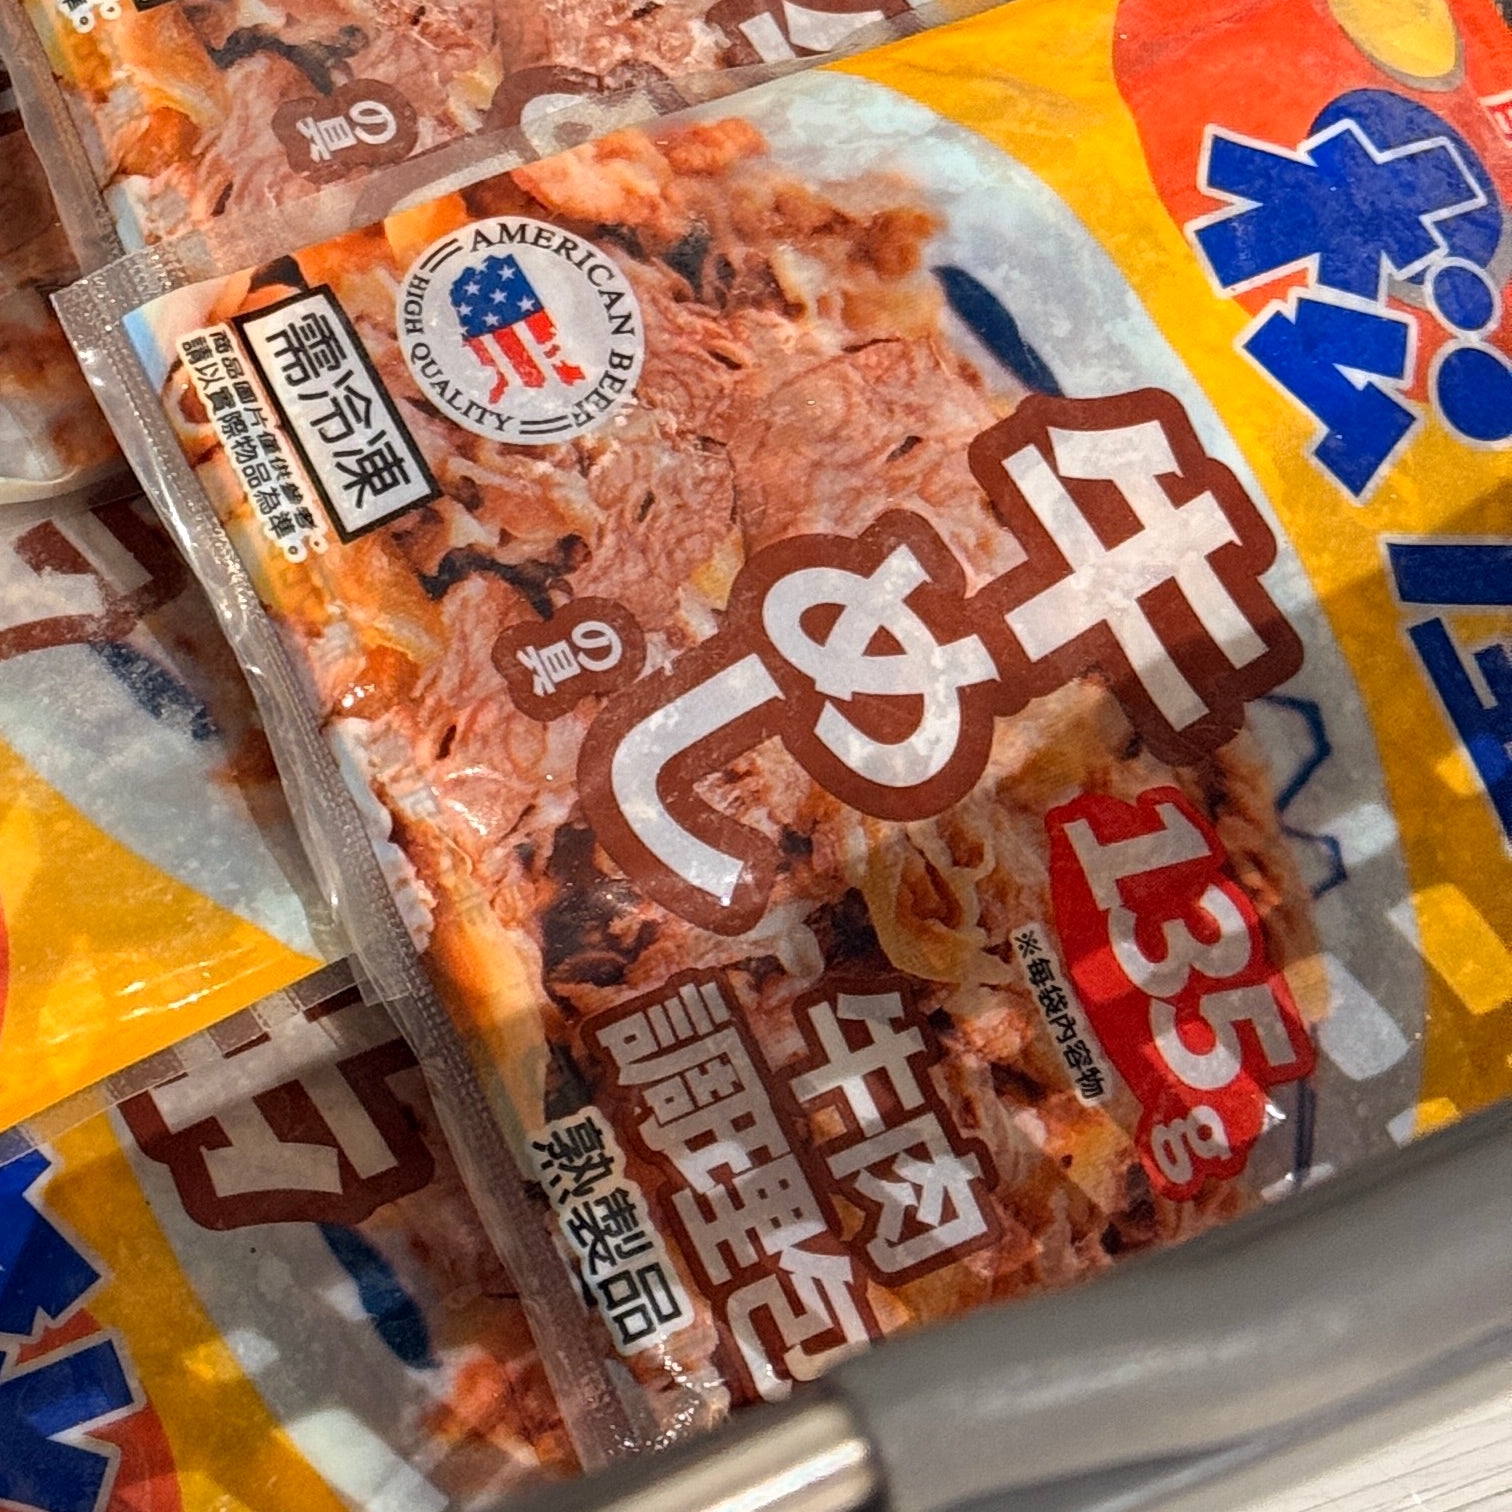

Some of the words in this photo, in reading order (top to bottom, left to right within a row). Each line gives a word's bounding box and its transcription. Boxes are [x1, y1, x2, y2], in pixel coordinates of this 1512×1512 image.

[297, 99, 398, 163] の具
[405, 271, 431, 336] HIGH
[408, 339, 515, 433] QUALITY
[469, 222, 636, 337] AMERICAN
[572, 349, 635, 430] BEEF
[265, 312, 411, 510] 需冷凍
[516, 618, 622, 698] の具
[610, 418, 1274, 908] 牛めし
[534, 1118, 684, 1348] 熟製品
[596, 982, 872, 1402] 調理包
[790, 988, 990, 1276] 牛肉
